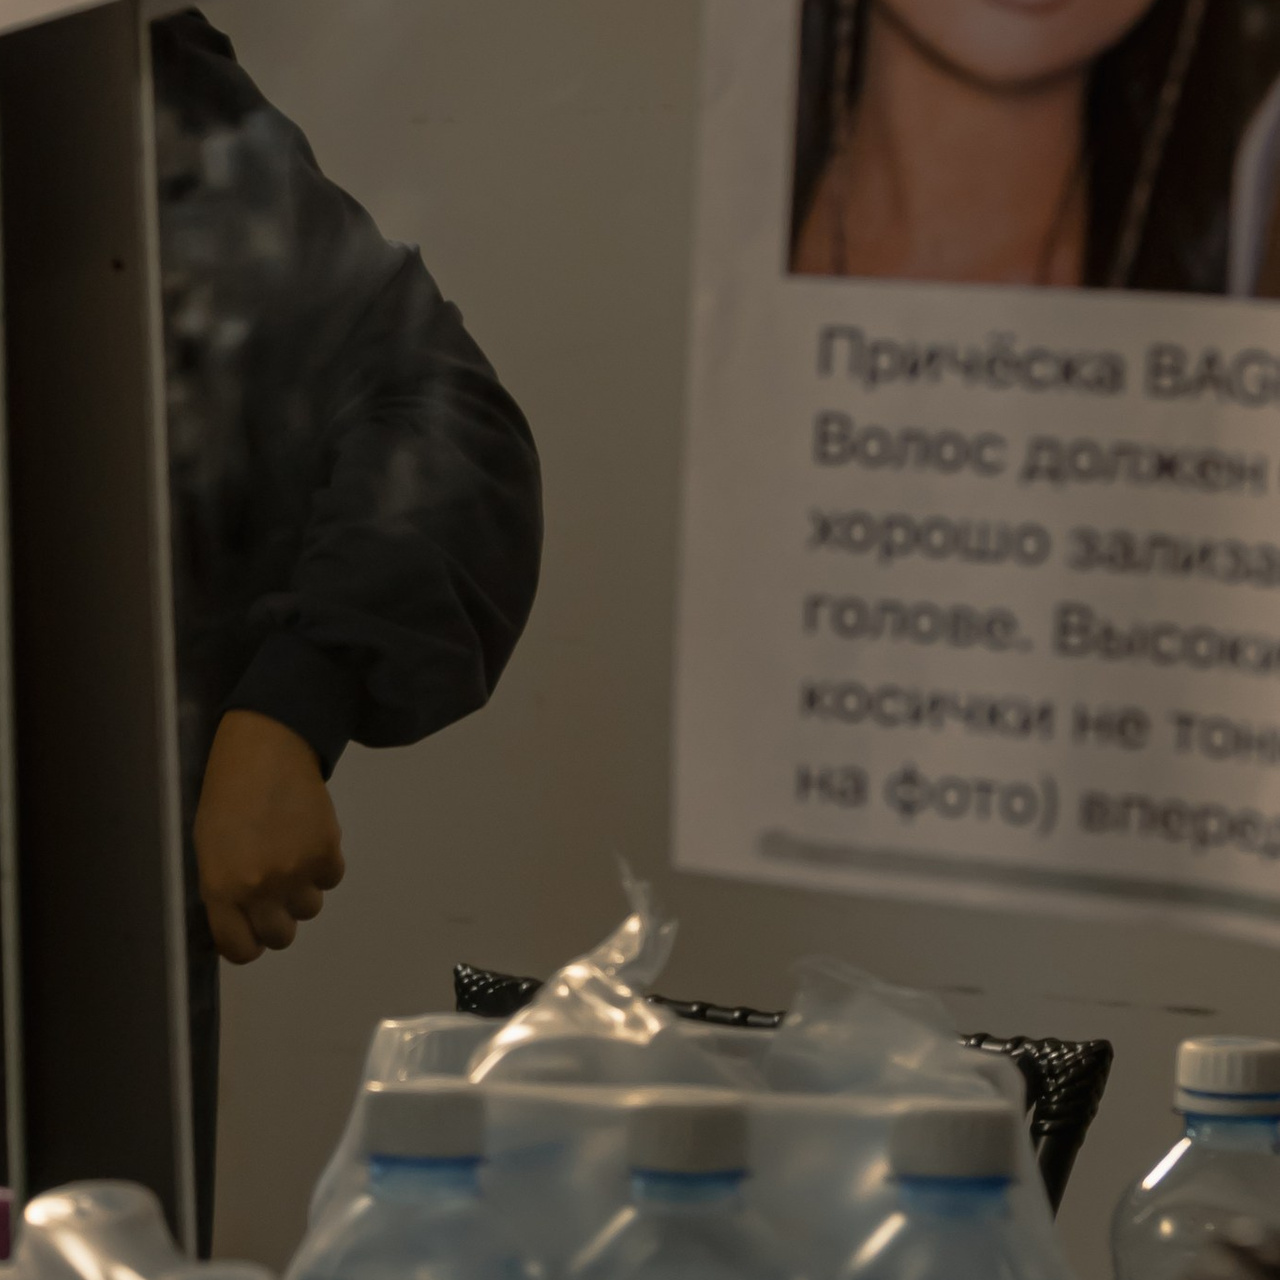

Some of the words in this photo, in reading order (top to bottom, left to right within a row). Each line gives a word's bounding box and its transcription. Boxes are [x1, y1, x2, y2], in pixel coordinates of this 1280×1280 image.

[818, 324, 1126, 394] Причёска
[812, 408, 1009, 477] Волос
[1020, 434, 1269, 496] должен
[808, 509, 1051, 568] хорошо
[802, 592, 1033, 653] голове.
[800, 680, 1055, 741] косички
[1072, 701, 1152, 752] не
[795, 761, 870, 810] на
[884, 761, 1060, 838] фото)
